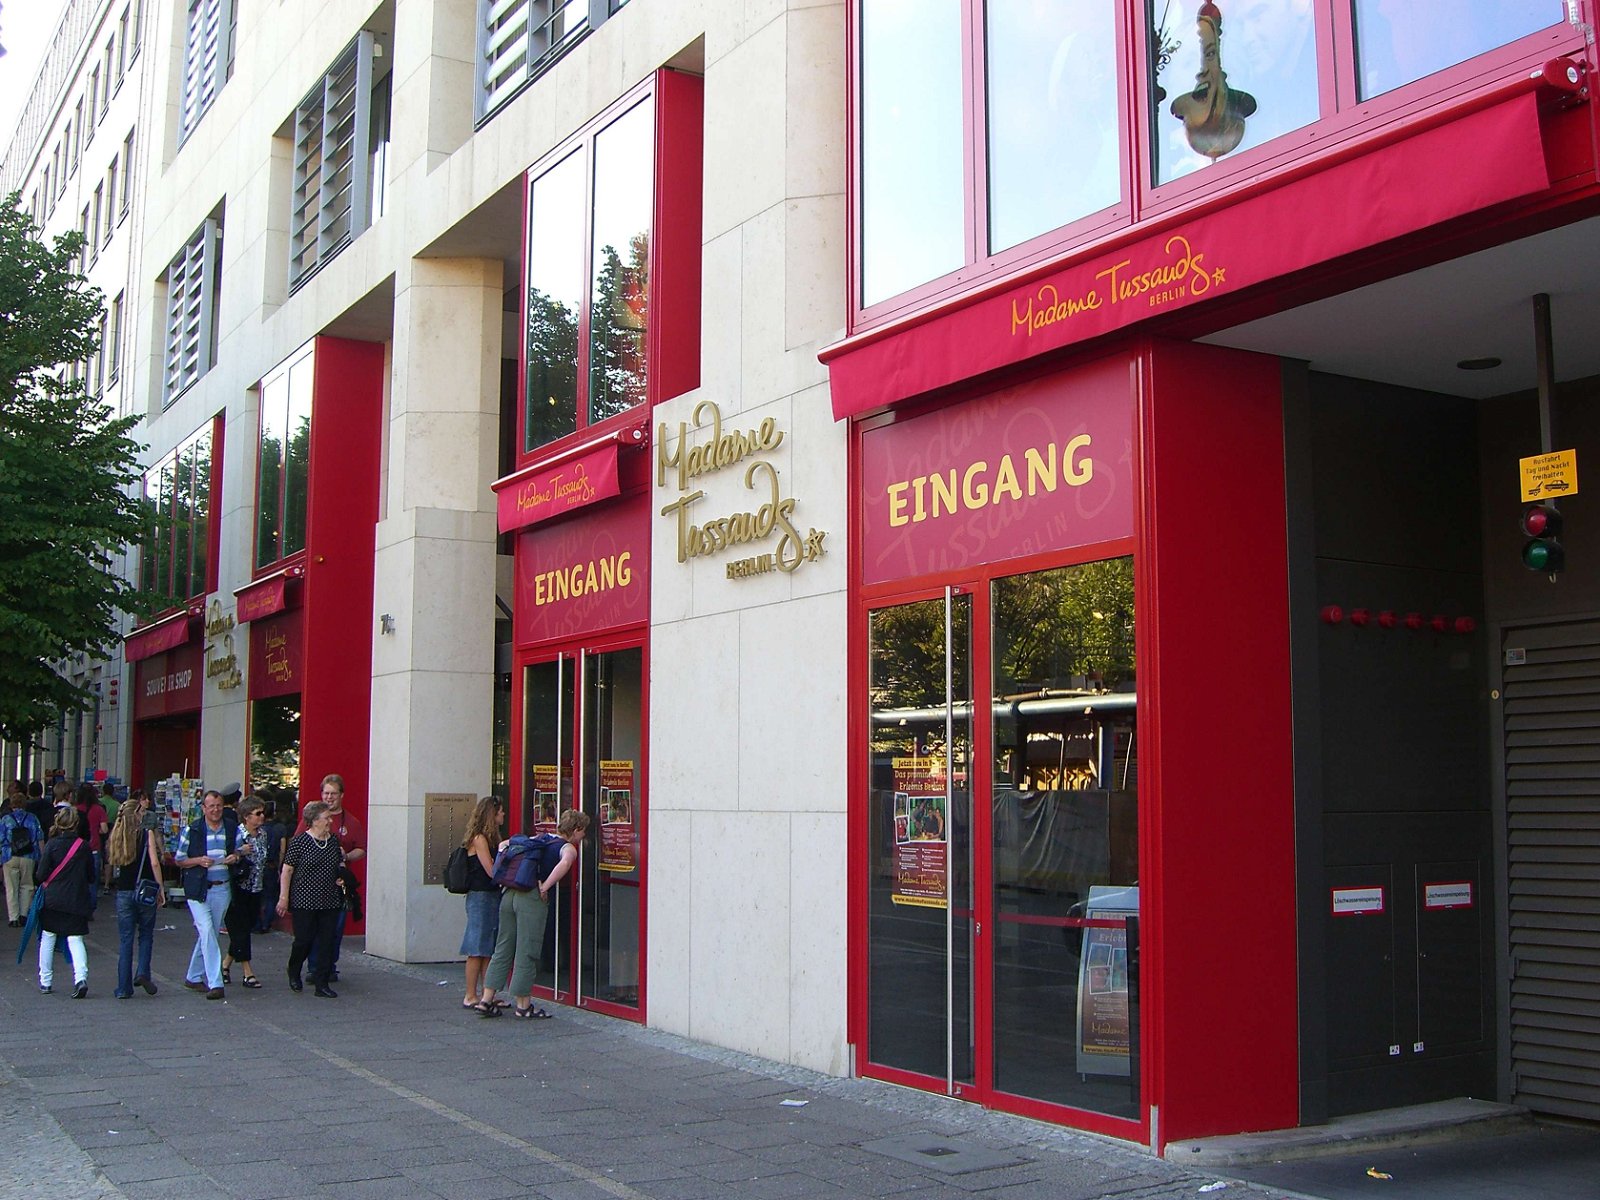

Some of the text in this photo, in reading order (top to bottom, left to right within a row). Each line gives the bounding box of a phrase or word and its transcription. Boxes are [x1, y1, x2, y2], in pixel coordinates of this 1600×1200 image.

[1011, 235, 1210, 337] Madame Tussauds
[1149, 285, 1186, 307] BERLIN
[658, 400, 785, 491] Madame
[517, 463, 590, 512] Madame Tussauds
[887, 434, 1093, 527] EINGANG
[661, 461, 803, 573] Tussauds
[534, 551, 631, 606] EINGANG
[726, 553, 772, 580] BERLIN
[175, 669, 193, 691] SHOP
